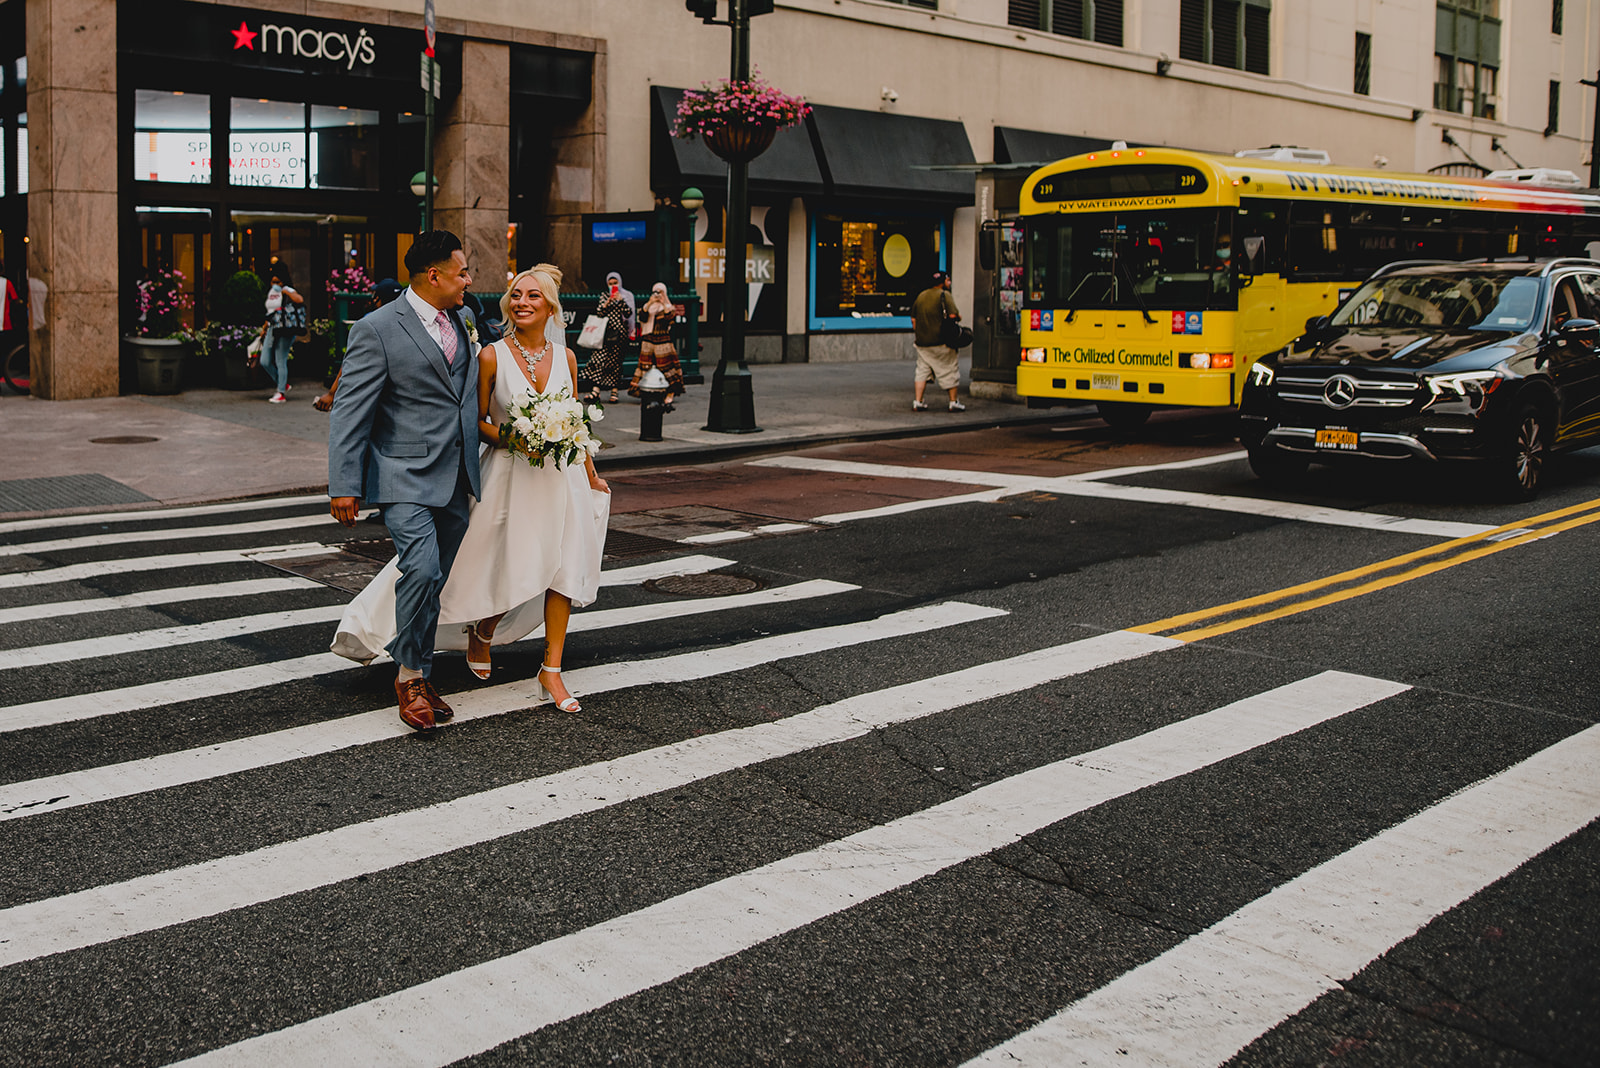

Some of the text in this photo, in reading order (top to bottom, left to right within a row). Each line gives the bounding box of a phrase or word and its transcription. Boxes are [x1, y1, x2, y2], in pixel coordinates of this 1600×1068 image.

[187, 141, 292, 153] SPD YOUR
[279, 174, 296, 186] AT
[1180, 175, 1196, 187] 239
[1040, 184, 1053, 195] 239
[717, 258, 771, 279] PRK
[1052, 347, 1173, 367] The Civilized Commute!
